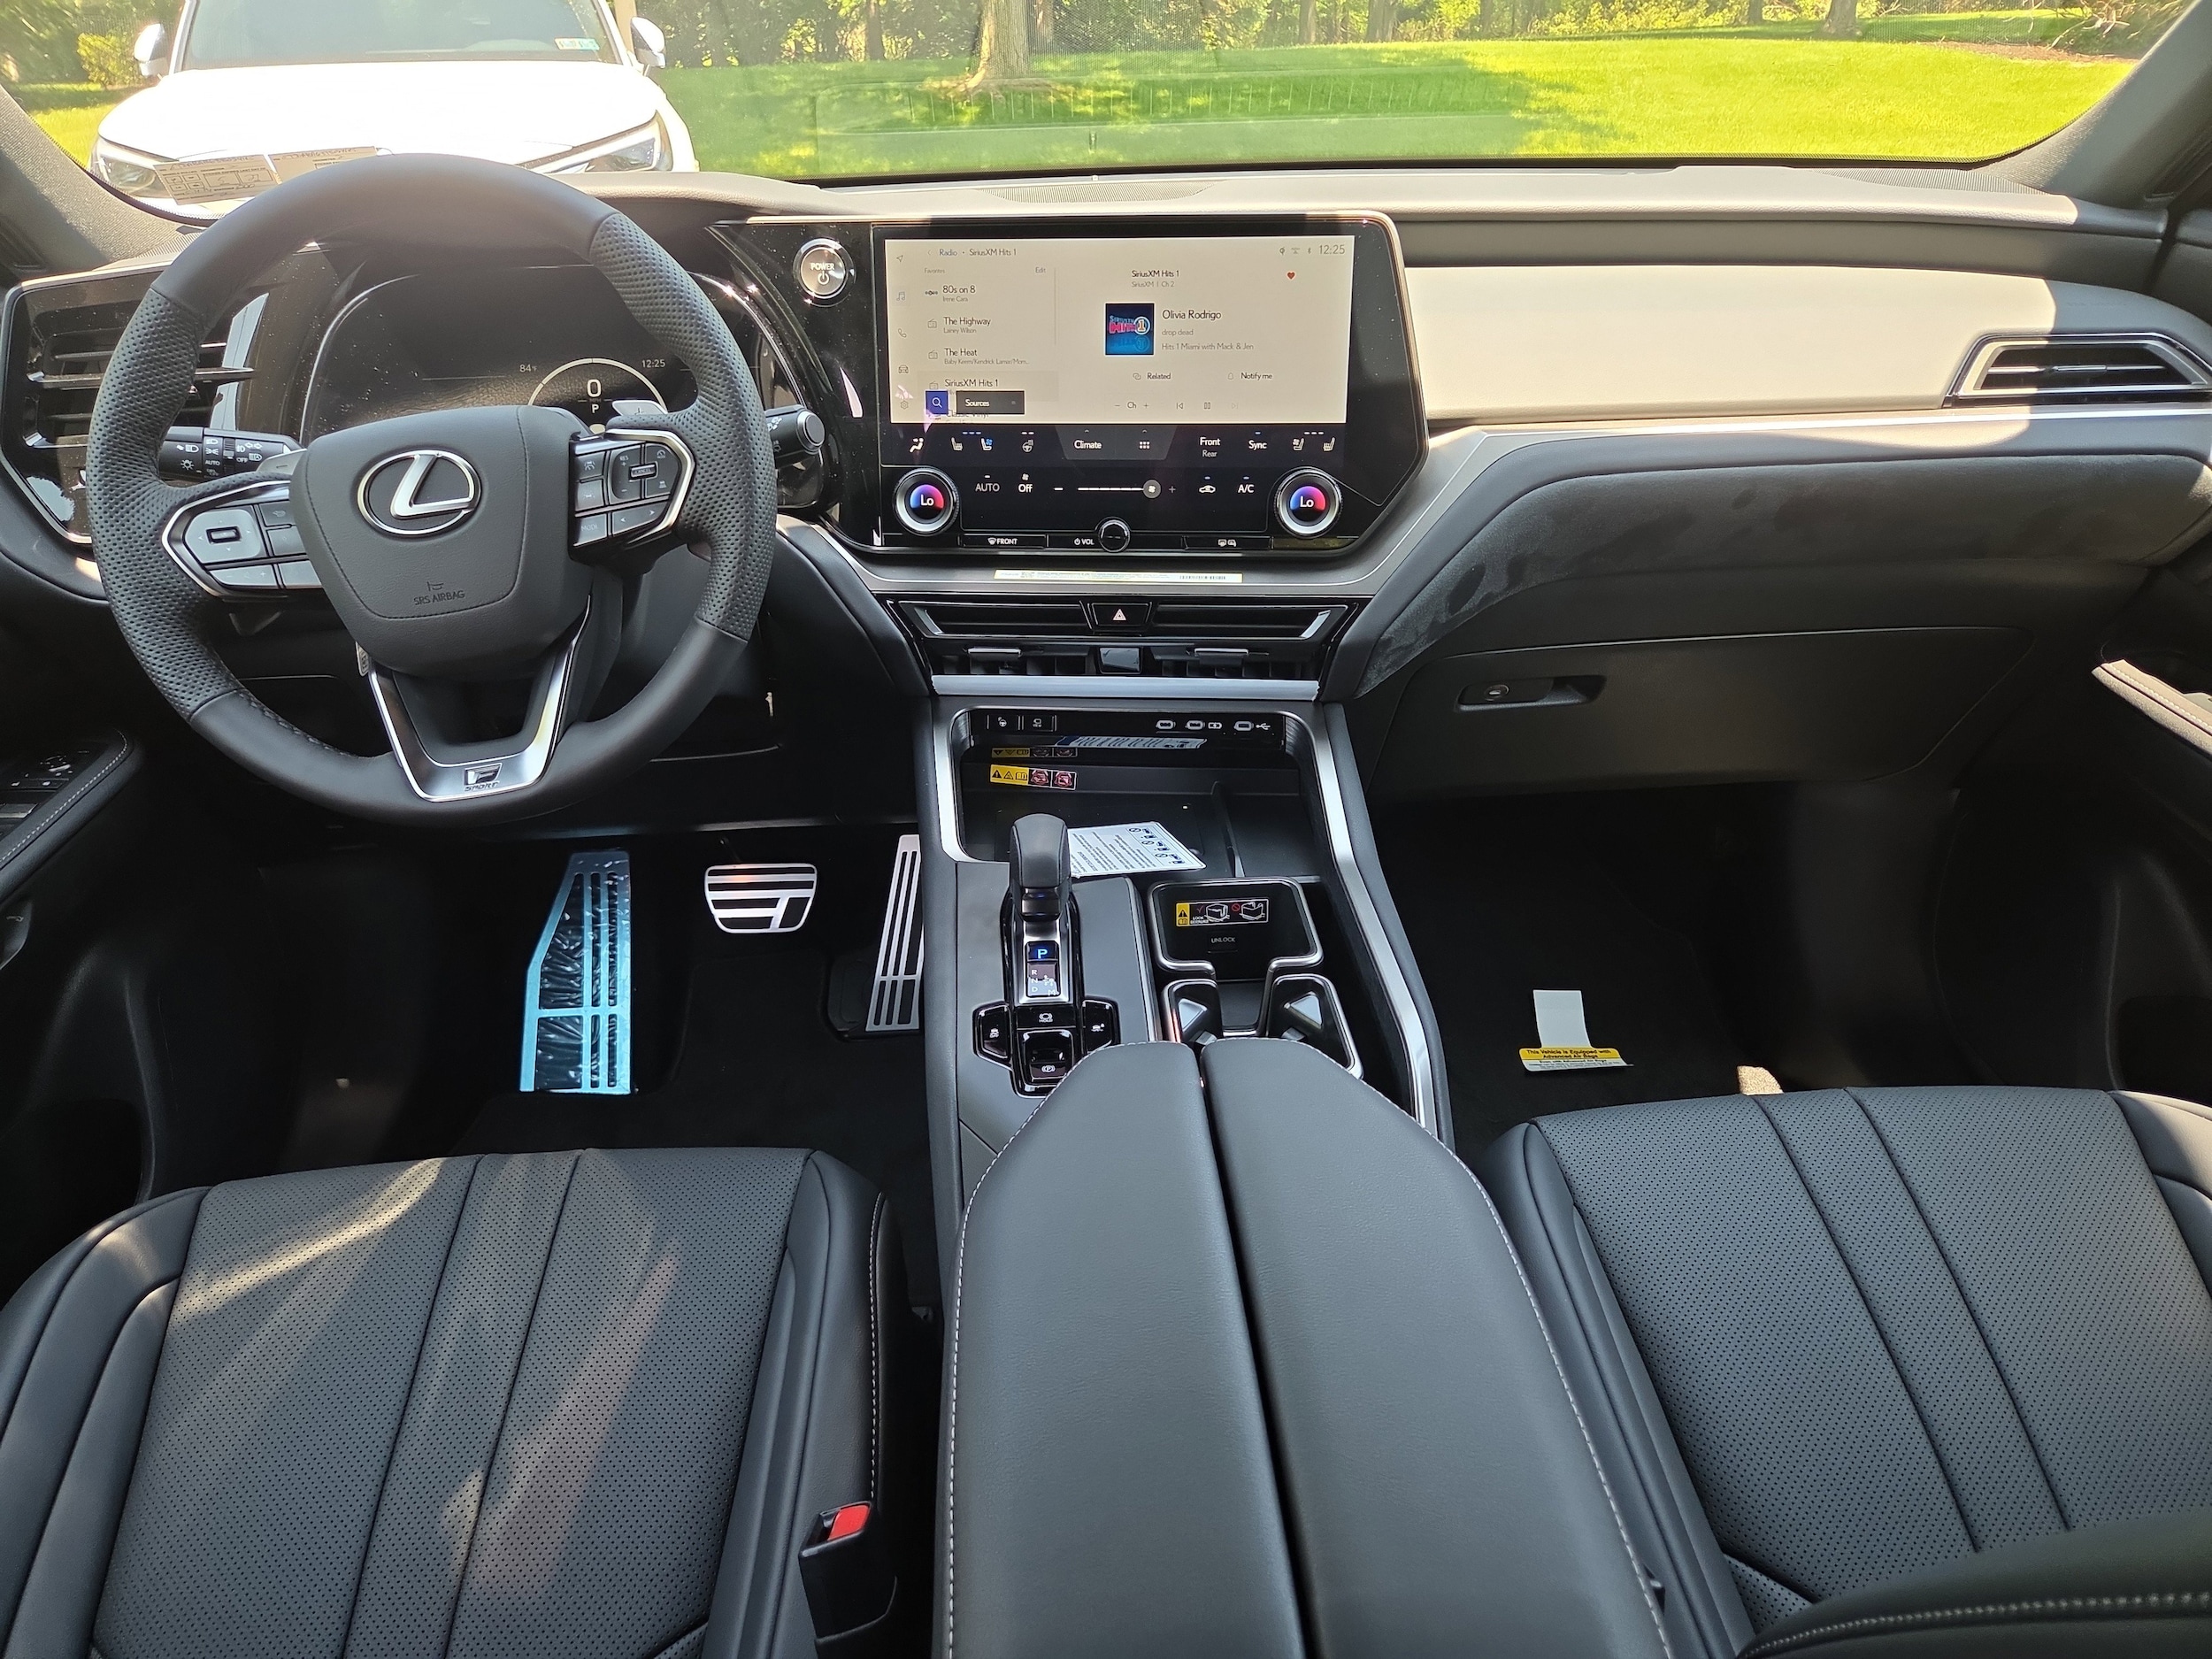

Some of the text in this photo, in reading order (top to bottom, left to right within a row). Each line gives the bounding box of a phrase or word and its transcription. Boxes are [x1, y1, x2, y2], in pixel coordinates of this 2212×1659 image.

[1319, 244, 1346, 255] 12:25
[943, 285, 957, 294] 80s
[970, 285, 976, 294] 8
[1162, 310, 1222, 321] Olivia Rodrigo
[943, 317, 991, 327] The Highway
[944, 348, 978, 357] The Heat
[641, 359, 666, 368] 12:25
[1240, 373, 1261, 381] Notify
[945, 379, 999, 388] SiriusXM Hits 1
[587, 379, 602, 398] 0
[964, 399, 990, 407] Sources
[591, 404, 600, 414] P
[1074, 440, 1102, 449] Climate
[1199, 437, 1221, 446] Front
[1248, 441, 1267, 451] Sync
[1202, 450, 1217, 458] Rear
[975, 483, 1000, 492] AUTO
[1018, 484, 1033, 492] Off
[1238, 484, 1254, 494] A/C
[920, 494, 934, 507] Lo
[1300, 495, 1314, 508] Lo
[414, 590, 465, 605] SRS AIRBAG
[1037, 949, 1048, 959] P
